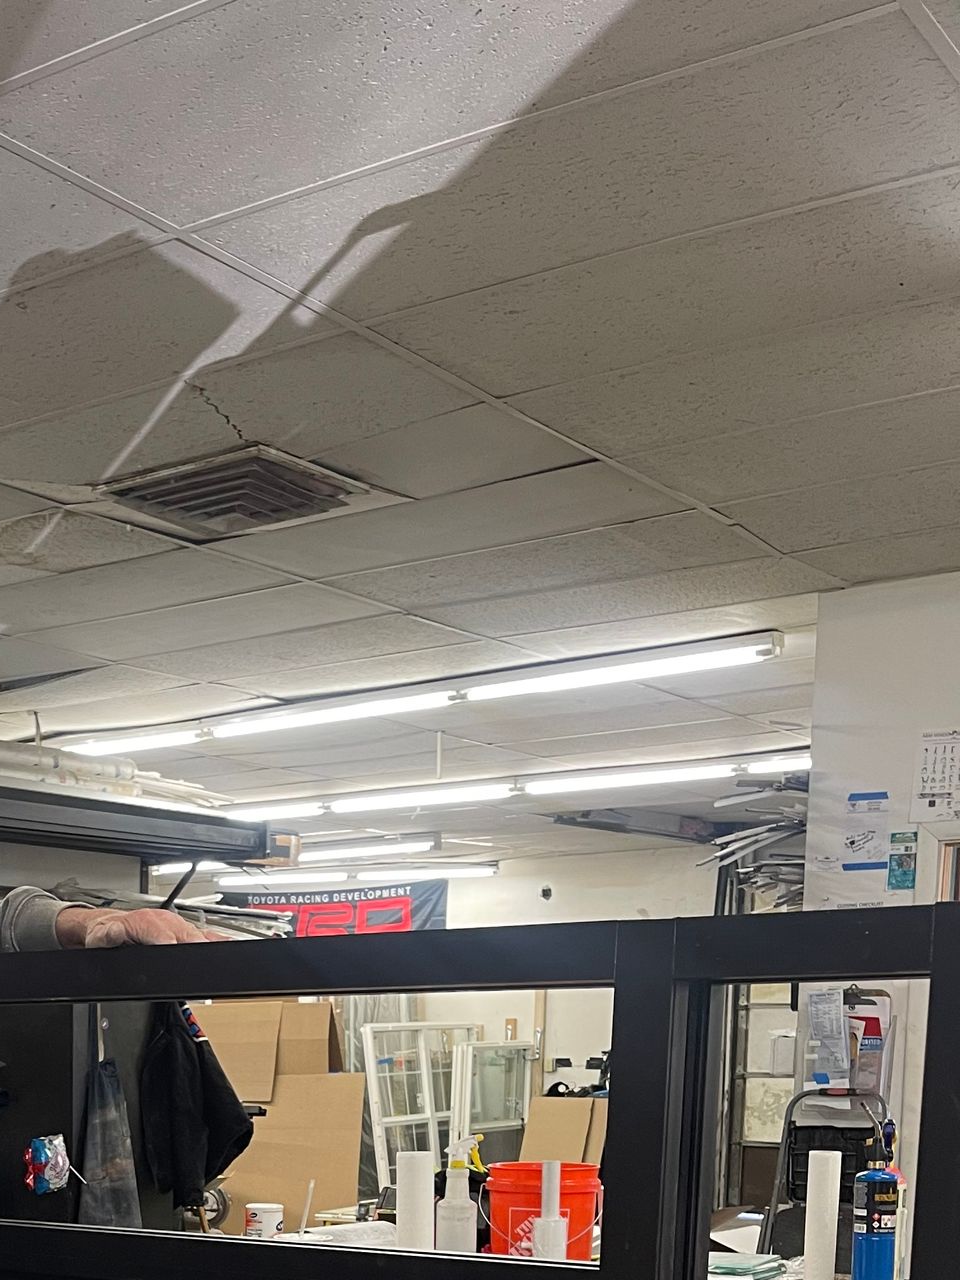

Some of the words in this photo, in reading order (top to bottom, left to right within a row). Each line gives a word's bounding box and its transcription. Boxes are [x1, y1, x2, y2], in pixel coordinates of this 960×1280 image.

[247, 895, 286, 905] TOYOTA
[290, 894, 329, 904] RACING
[333, 886, 412, 901] DEVELOPMENT
